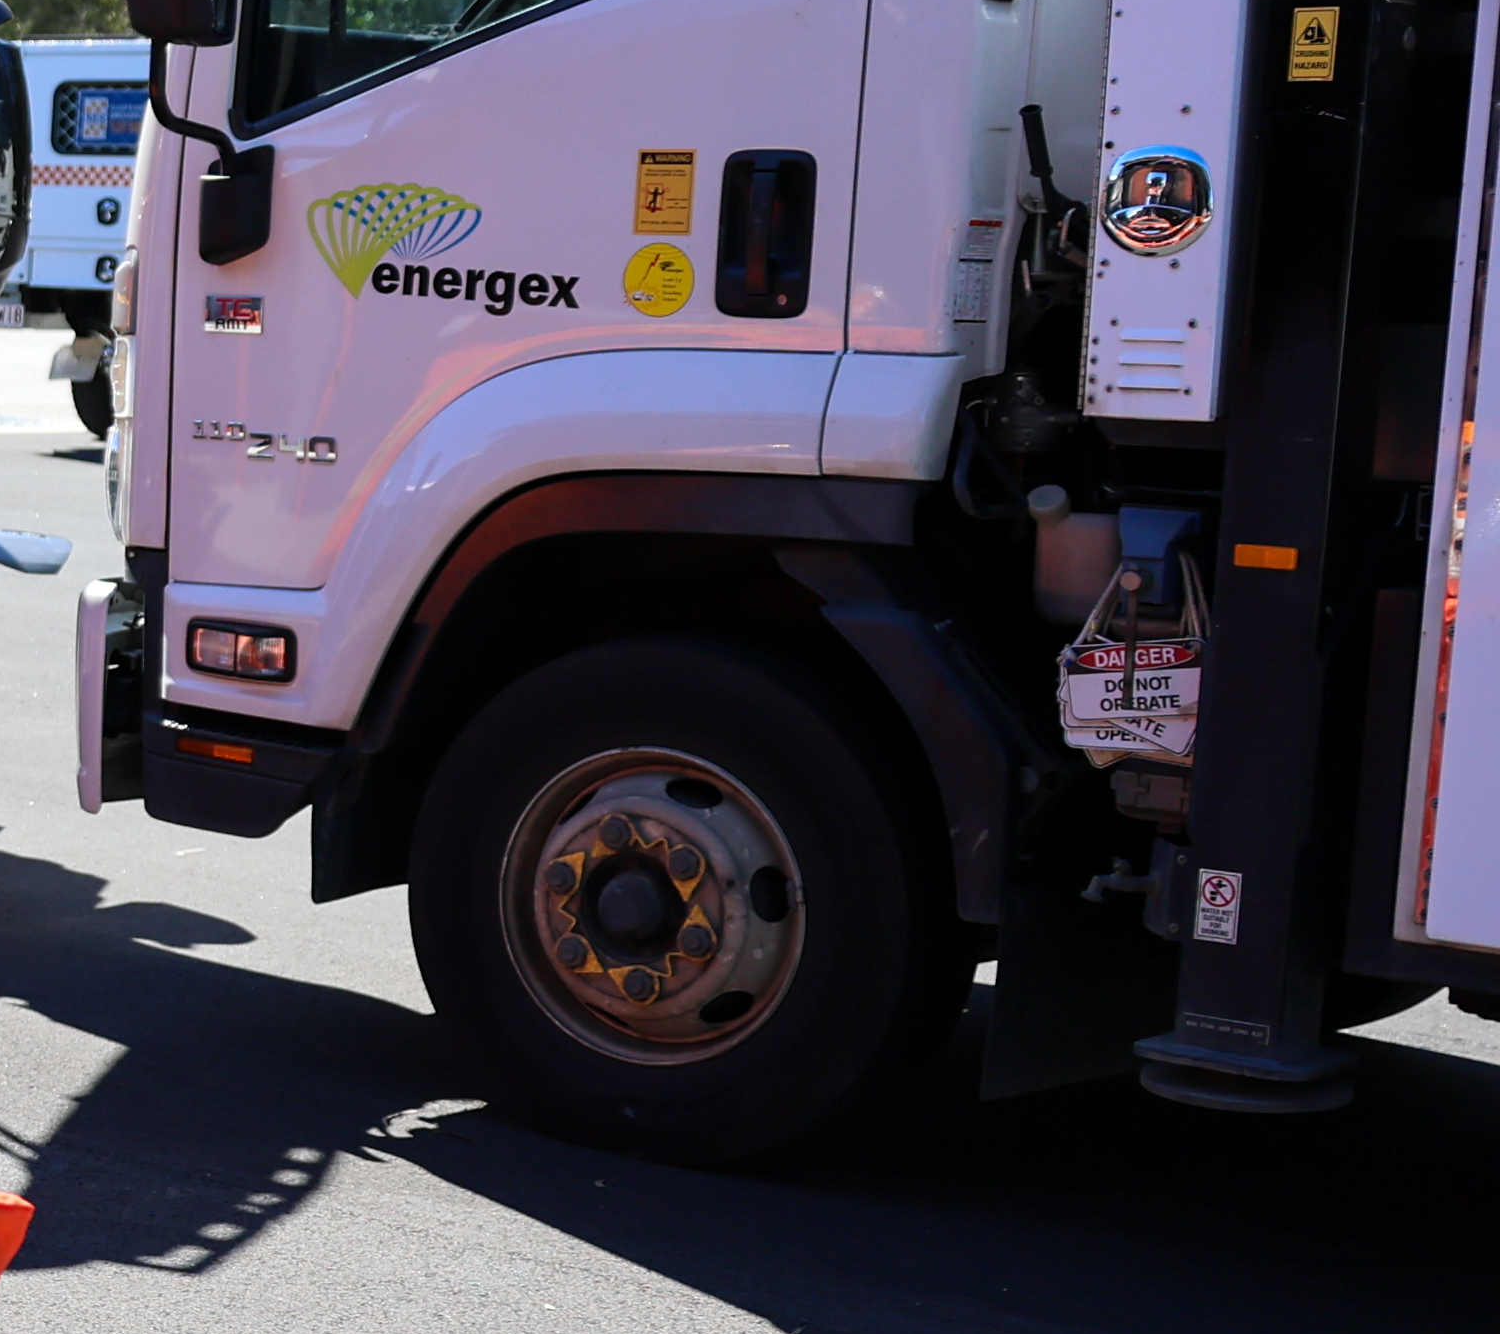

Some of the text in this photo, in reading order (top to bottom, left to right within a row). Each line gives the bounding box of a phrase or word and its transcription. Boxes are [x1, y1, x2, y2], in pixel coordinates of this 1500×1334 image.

[655, 153, 692, 162] WARNING
[372, 263, 580, 315] energex
[193, 419, 338, 463] 110 240
[1136, 676, 1172, 691] NOT
